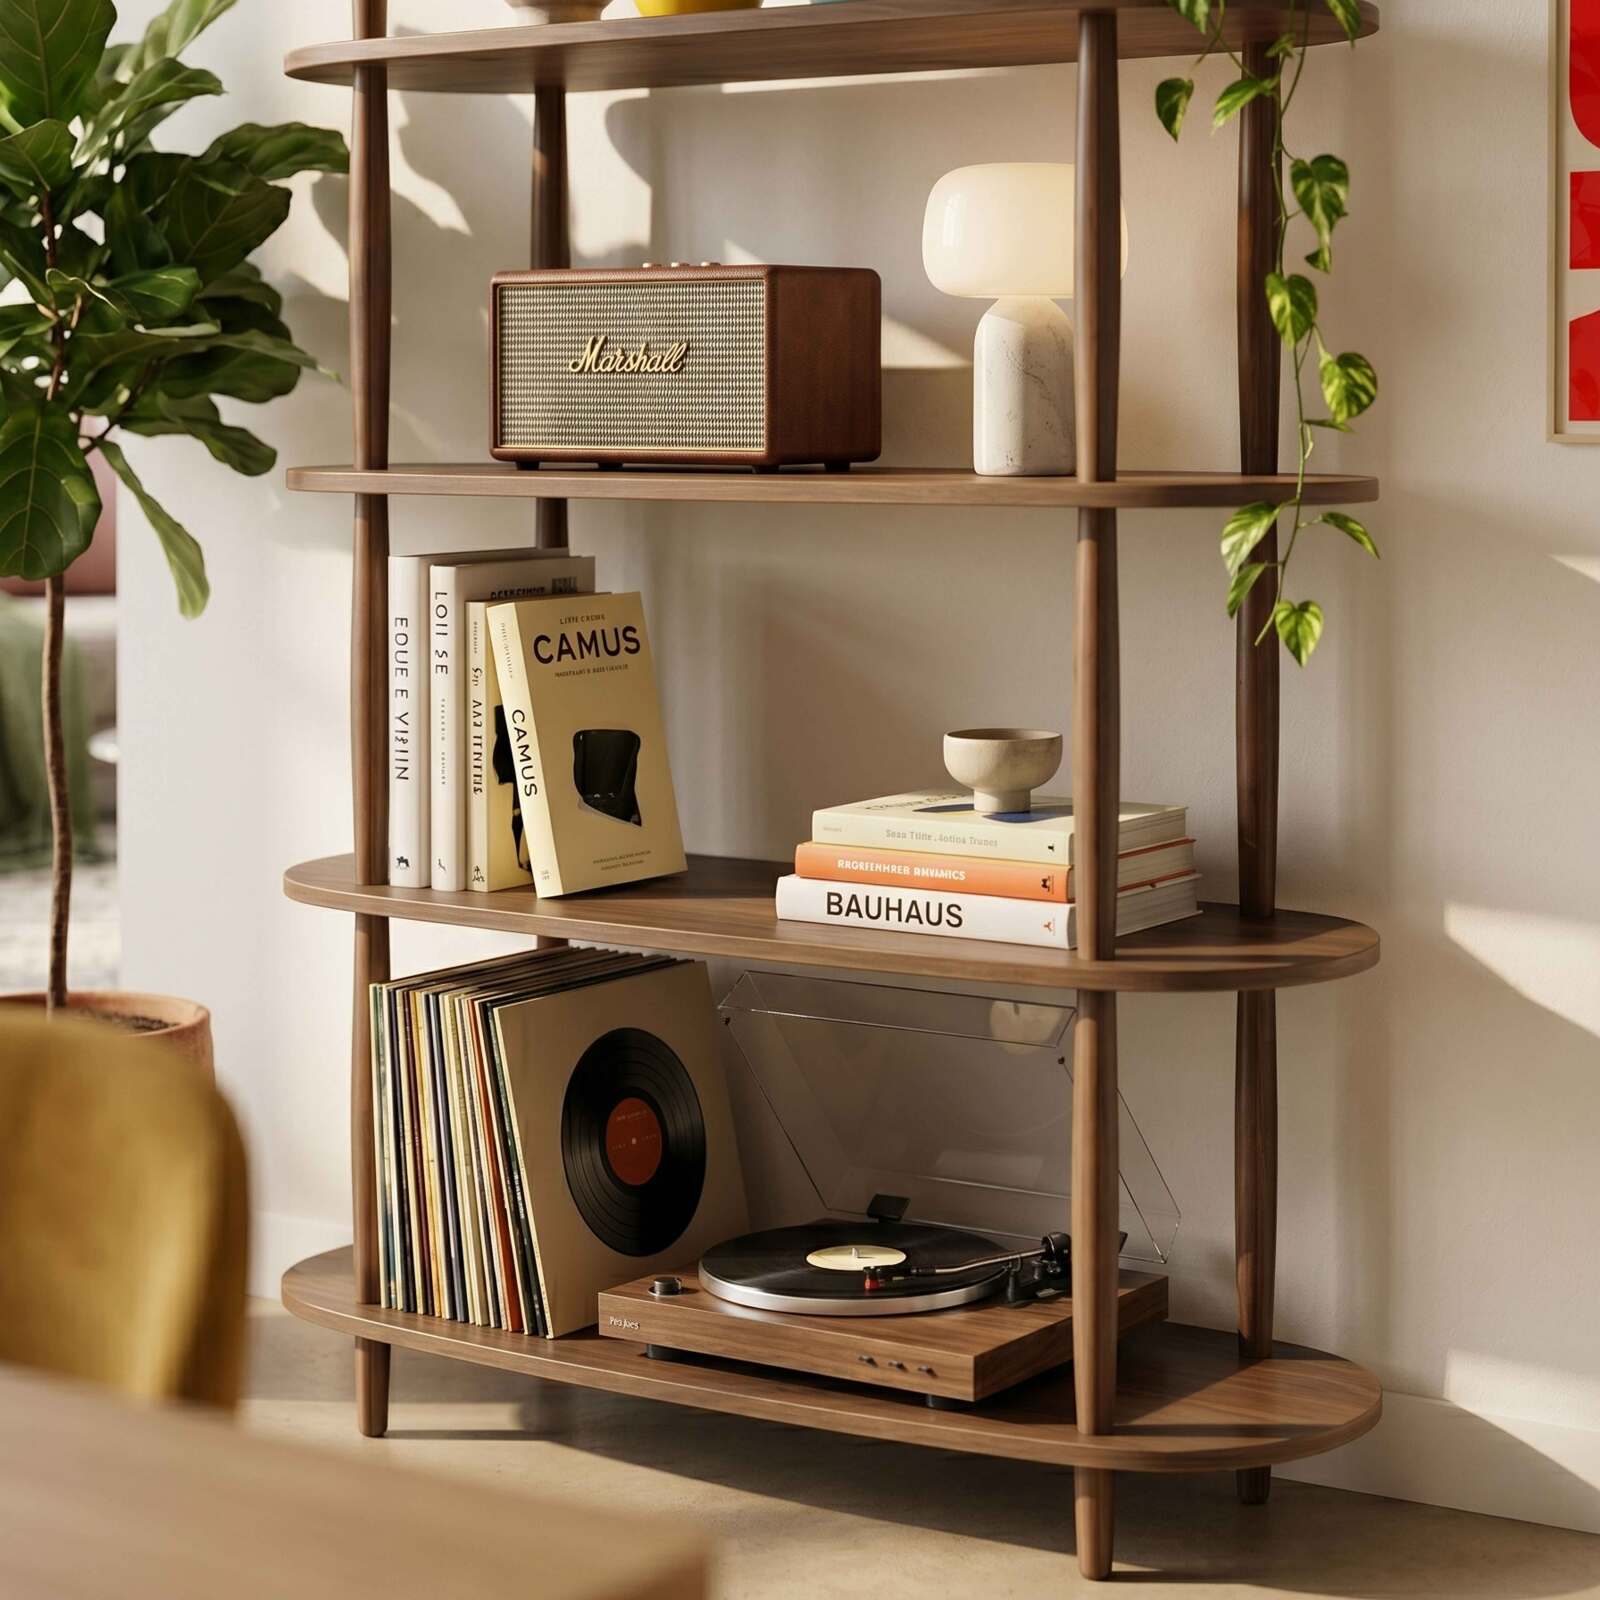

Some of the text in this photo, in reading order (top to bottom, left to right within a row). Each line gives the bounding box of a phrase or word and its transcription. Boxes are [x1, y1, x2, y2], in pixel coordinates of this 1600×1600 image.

[568, 334, 687, 374] Marshall
[533, 625, 642, 665] CAMUS
[511, 708, 538, 797] CAMUS
[826, 891, 964, 928] BAUHAUS
